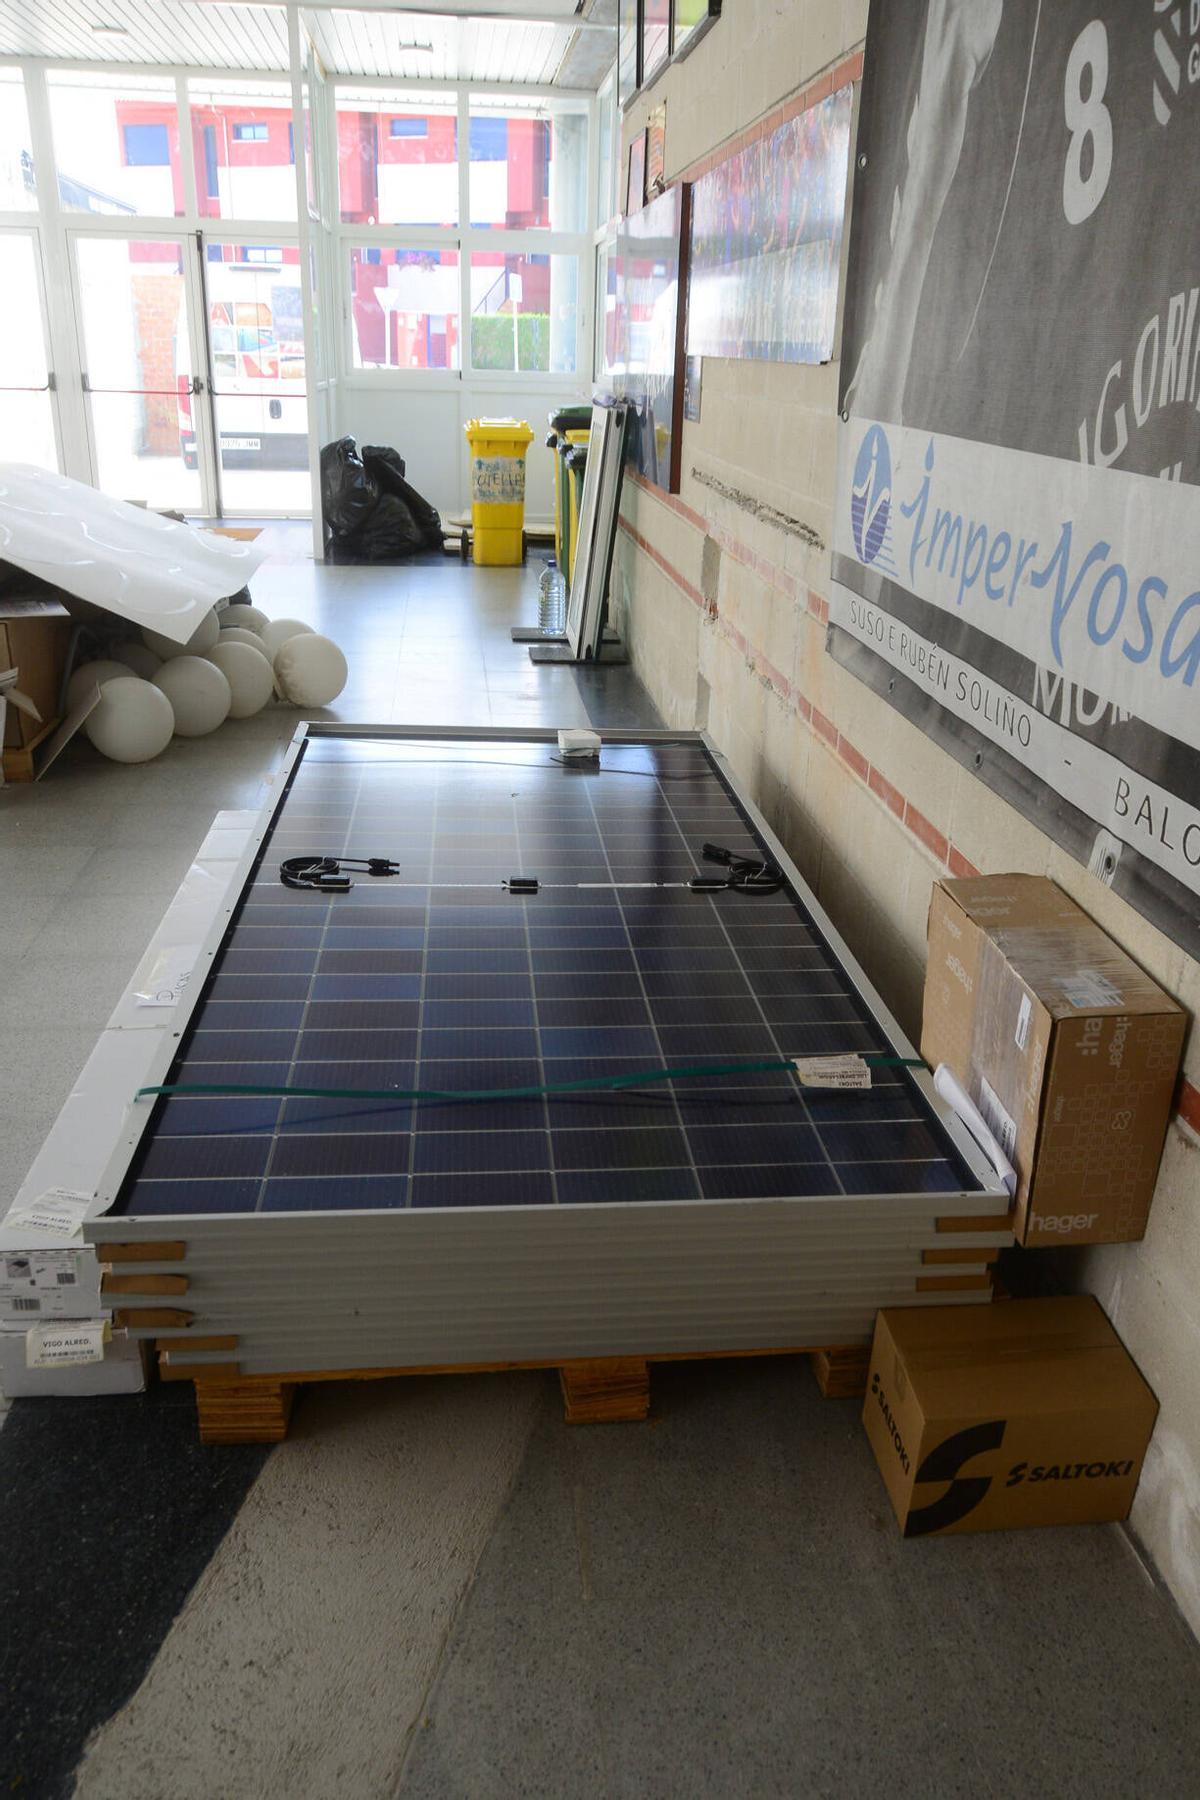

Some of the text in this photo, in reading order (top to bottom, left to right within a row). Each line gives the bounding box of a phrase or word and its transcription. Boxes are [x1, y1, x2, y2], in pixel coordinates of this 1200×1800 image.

[1063, 19, 1113, 225] 8
[850, 600, 884, 642] SUSO
[888, 625, 896, 651] E
[900, 632, 950, 690] RUBÉN
[955, 671, 1031, 747] SOLIÑO
[1028, 1211, 1100, 1233] hager
[42, 1340, 63, 1348] VIGO
[879, 1390, 910, 1476] SALTOKI
[1028, 1460, 1134, 1481] SALTOKI
